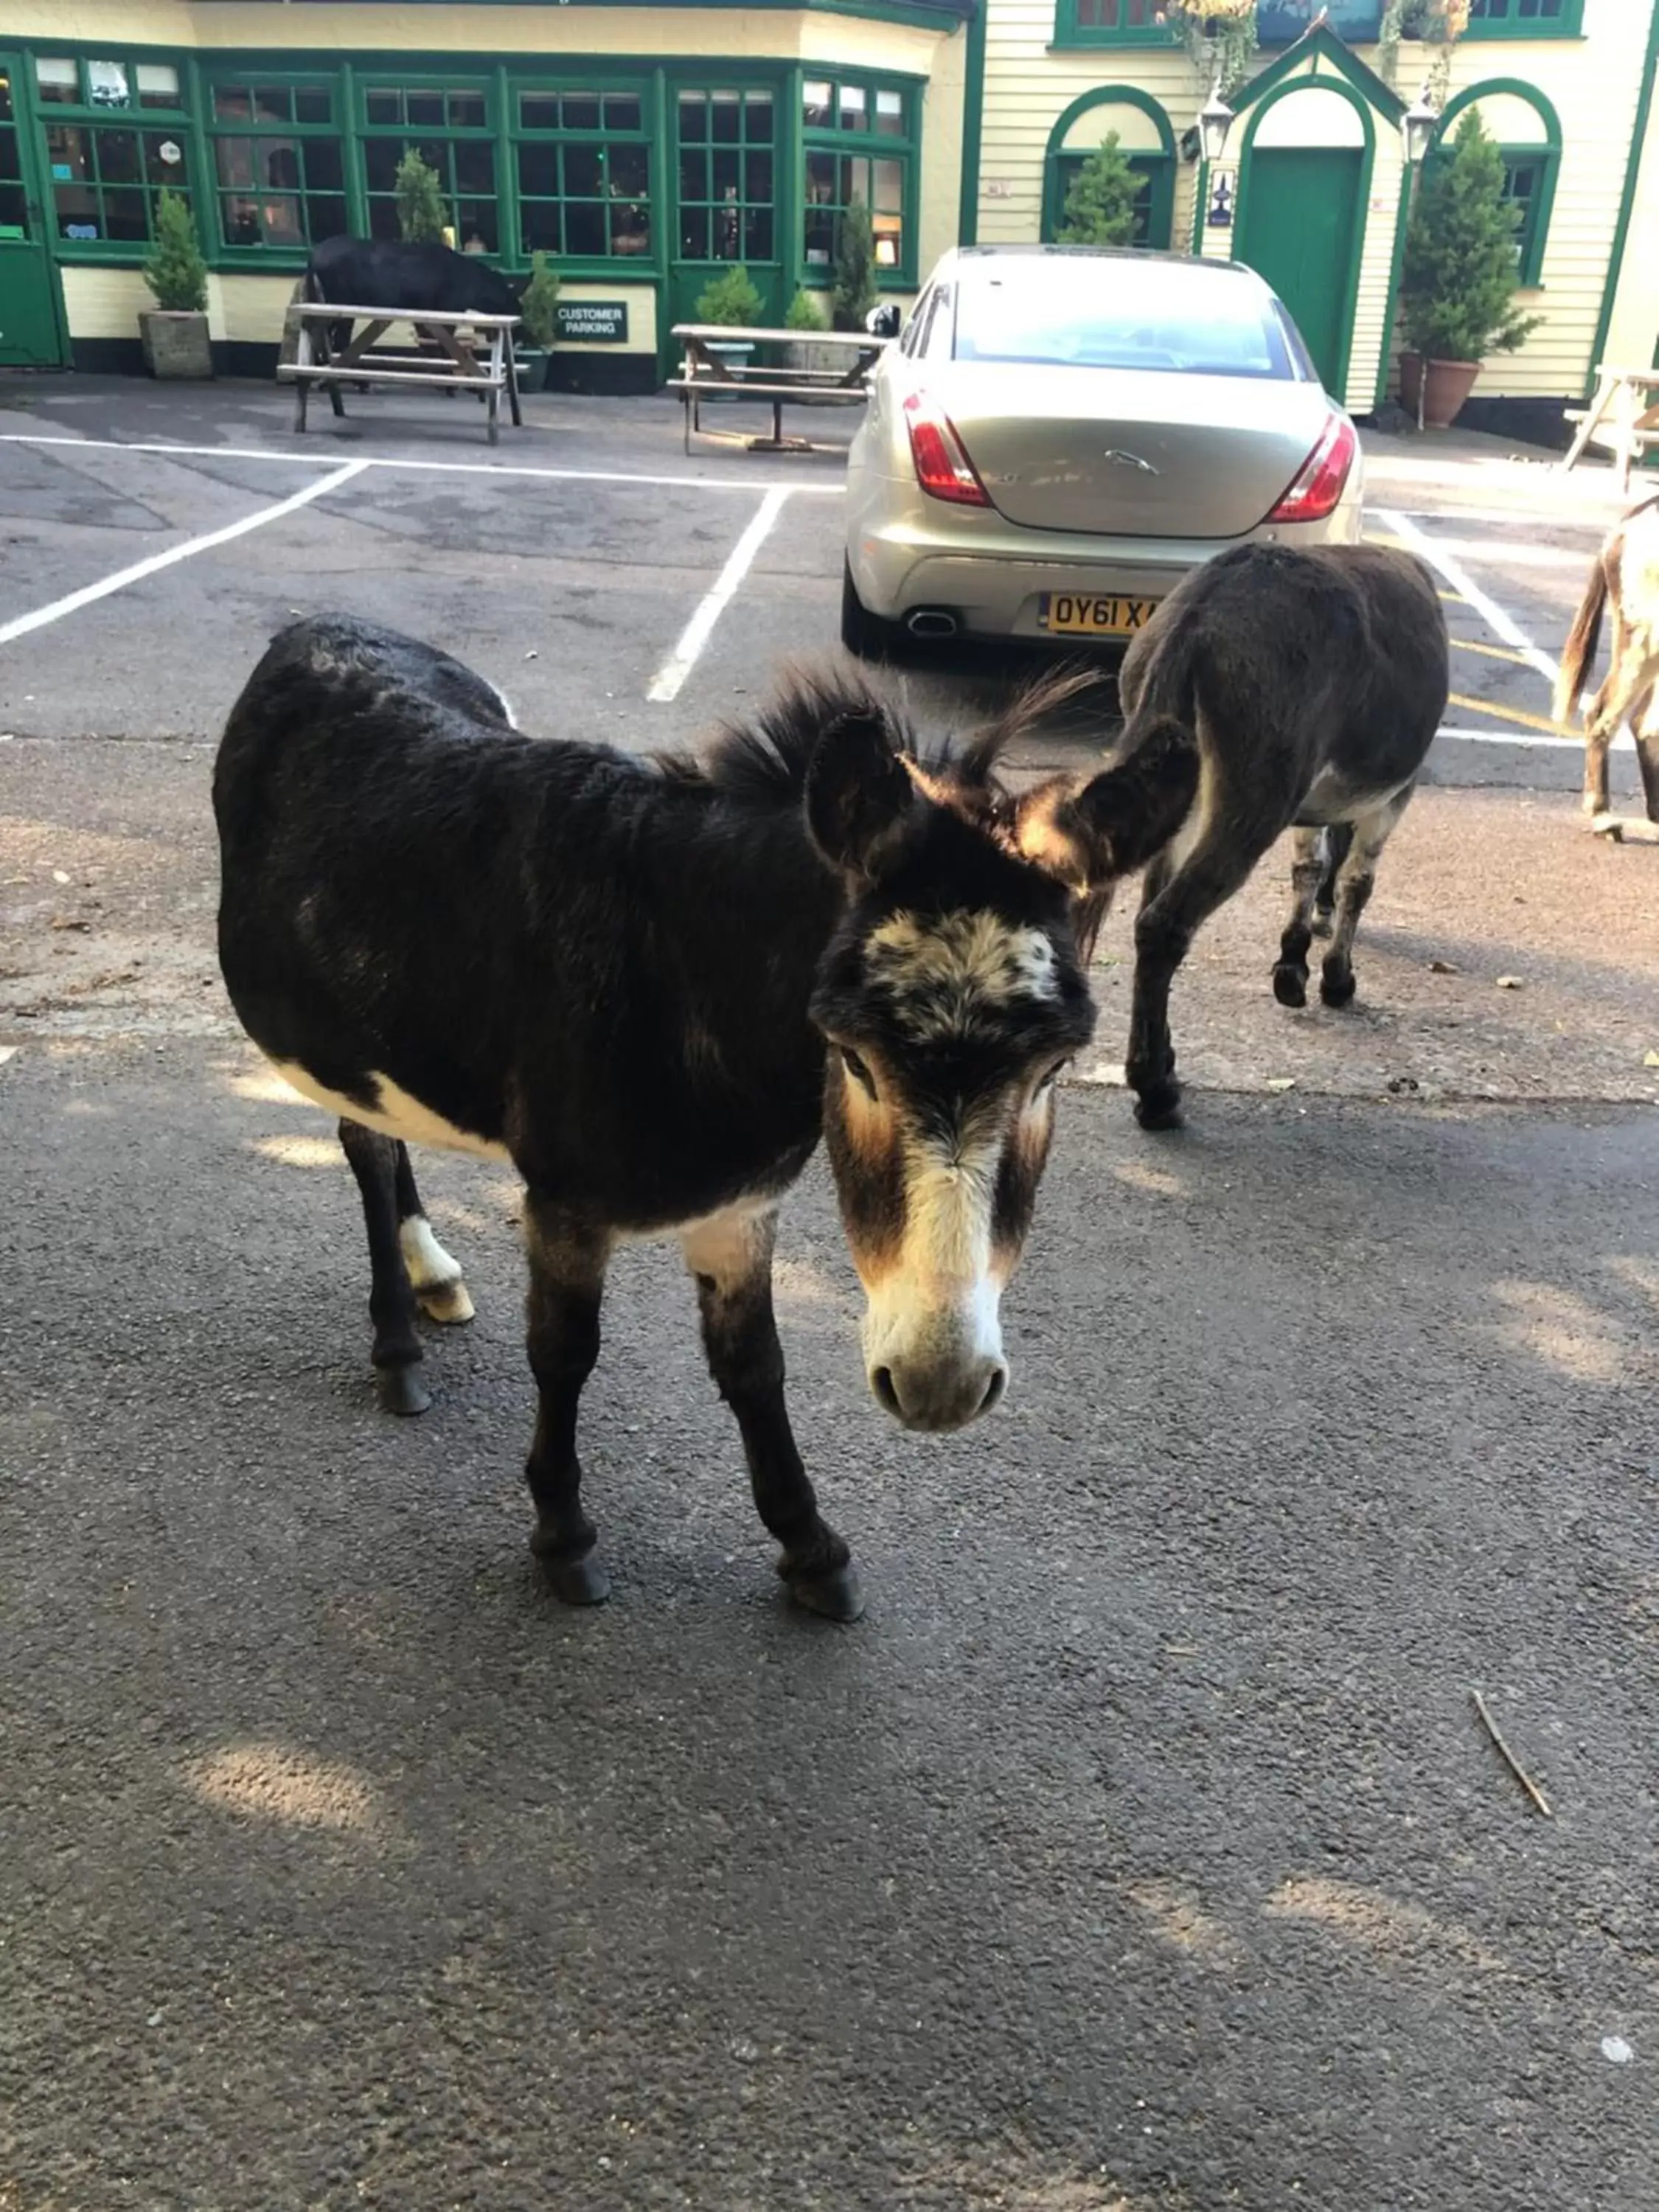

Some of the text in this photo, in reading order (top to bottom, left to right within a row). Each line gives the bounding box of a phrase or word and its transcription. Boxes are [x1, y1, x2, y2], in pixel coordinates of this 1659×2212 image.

[558, 307, 622, 321] CUSTOMER
[566, 321, 616, 334] PARKING
[1056, 597, 1118, 626] OY61
